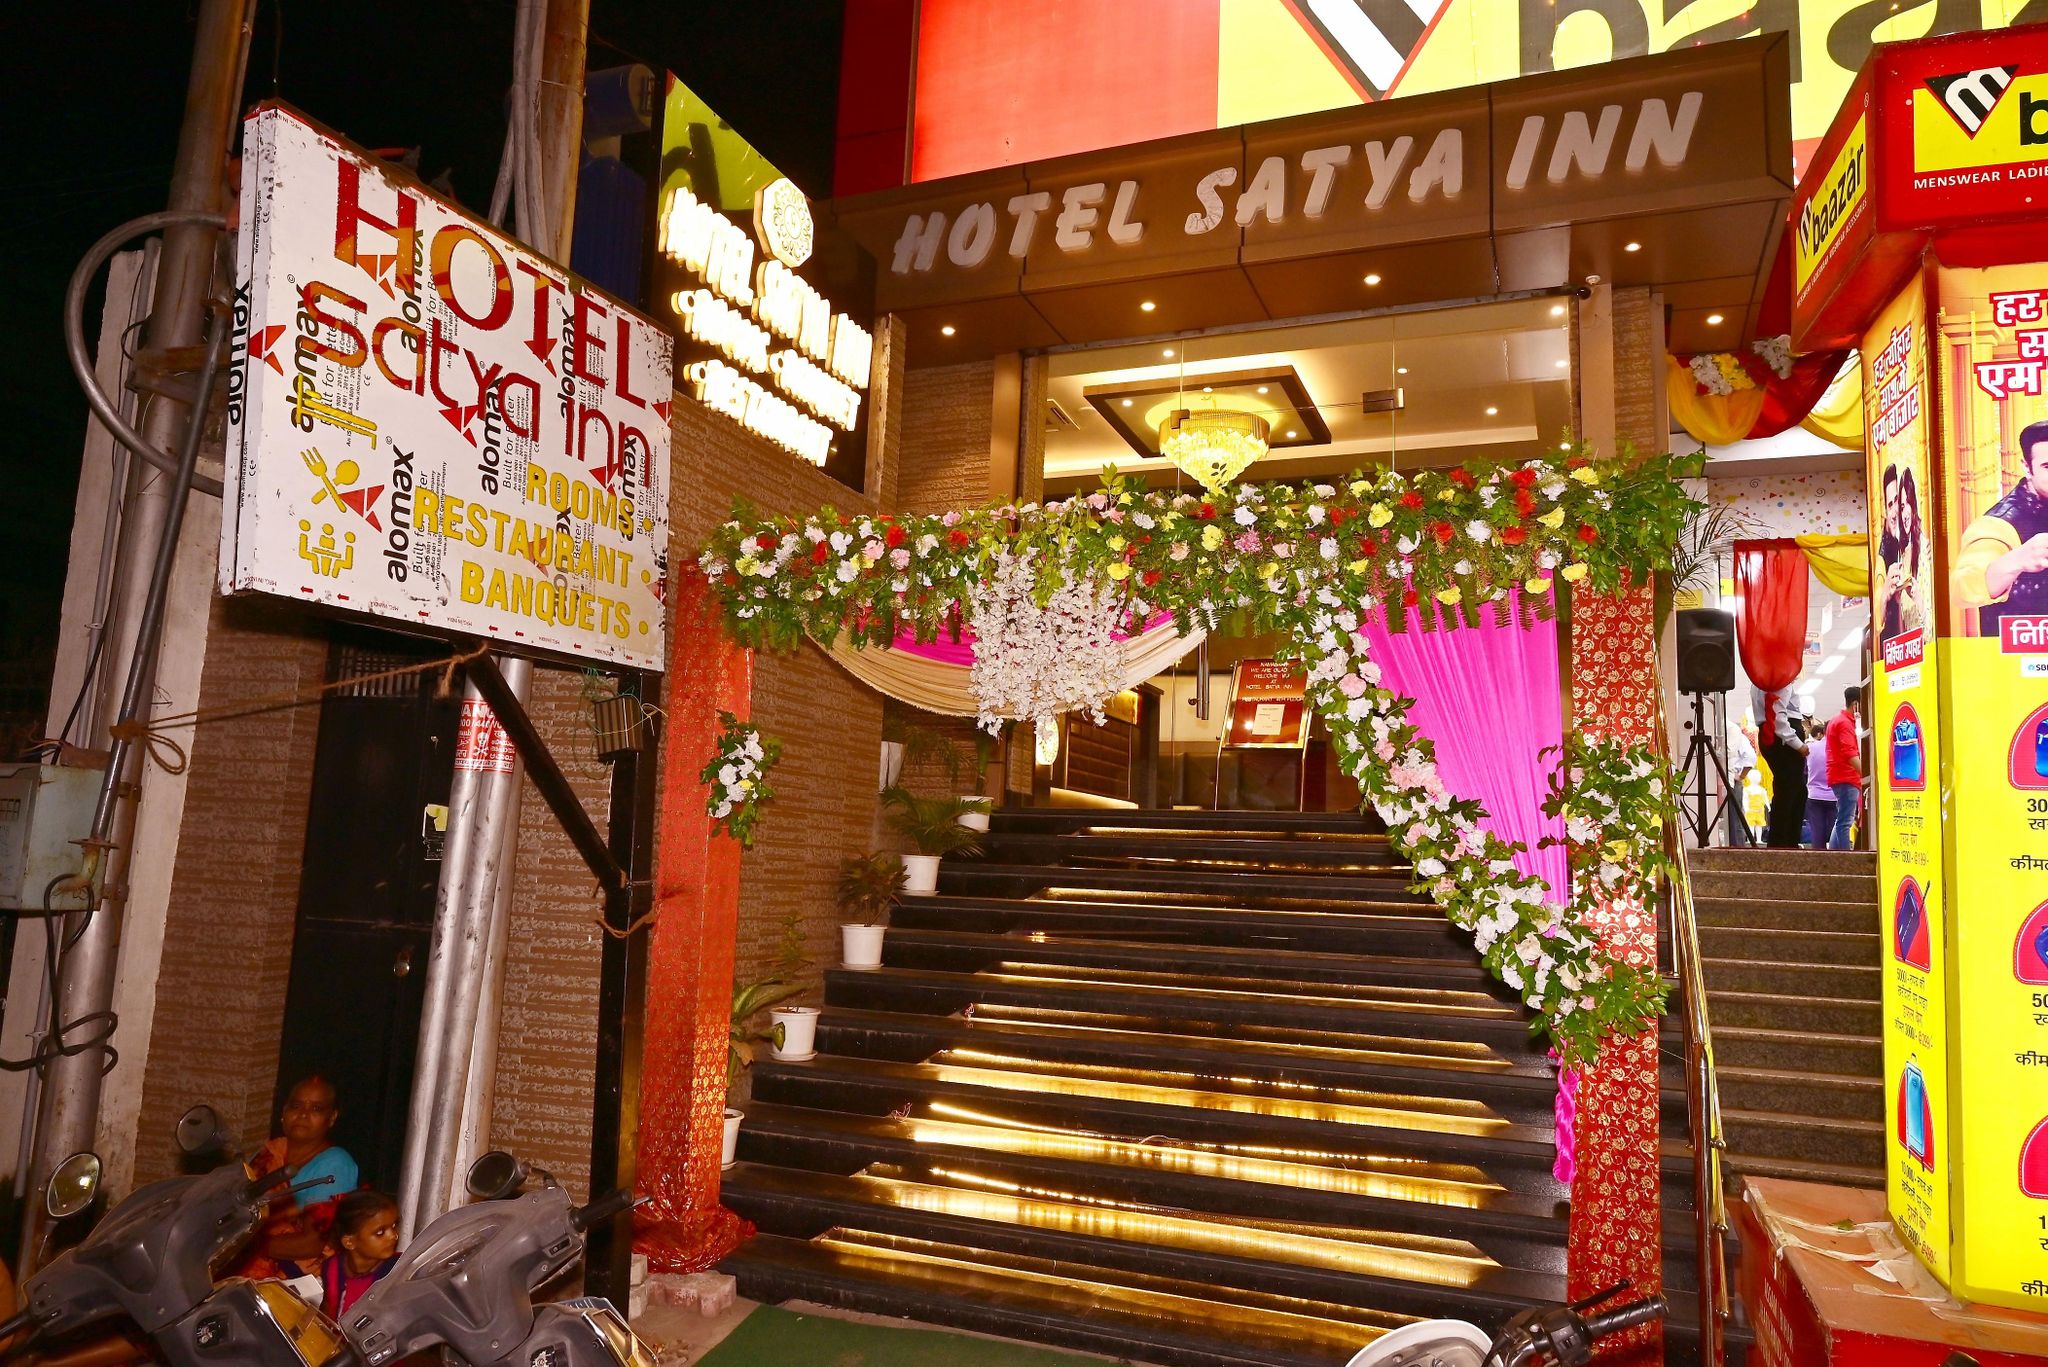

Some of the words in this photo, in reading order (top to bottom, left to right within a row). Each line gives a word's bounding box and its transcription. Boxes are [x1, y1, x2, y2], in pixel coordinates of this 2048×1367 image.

[891, 180, 1145, 275] HOTEL
[1183, 127, 1463, 236] SATYA
[1505, 91, 1703, 192] INN
[1812, 143, 1864, 257] baazar
[1914, 171, 2001, 190] MENSWEAR
[335, 156, 646, 408] HOTEL
[1993, 292, 2041, 325] हर
[228, 280, 249, 425] alomax
[322, 366, 335, 388] for
[1977, 362, 2044, 399] एम
[503, 459, 514, 489] Built
[504, 437, 514, 455] for
[383, 444, 414, 583] alomax
[527, 462, 634, 536] ROOMS
[412, 543, 423, 573] Built
[413, 486, 633, 588] RESTAURANT
[460, 560, 630, 639] BANQUETS
